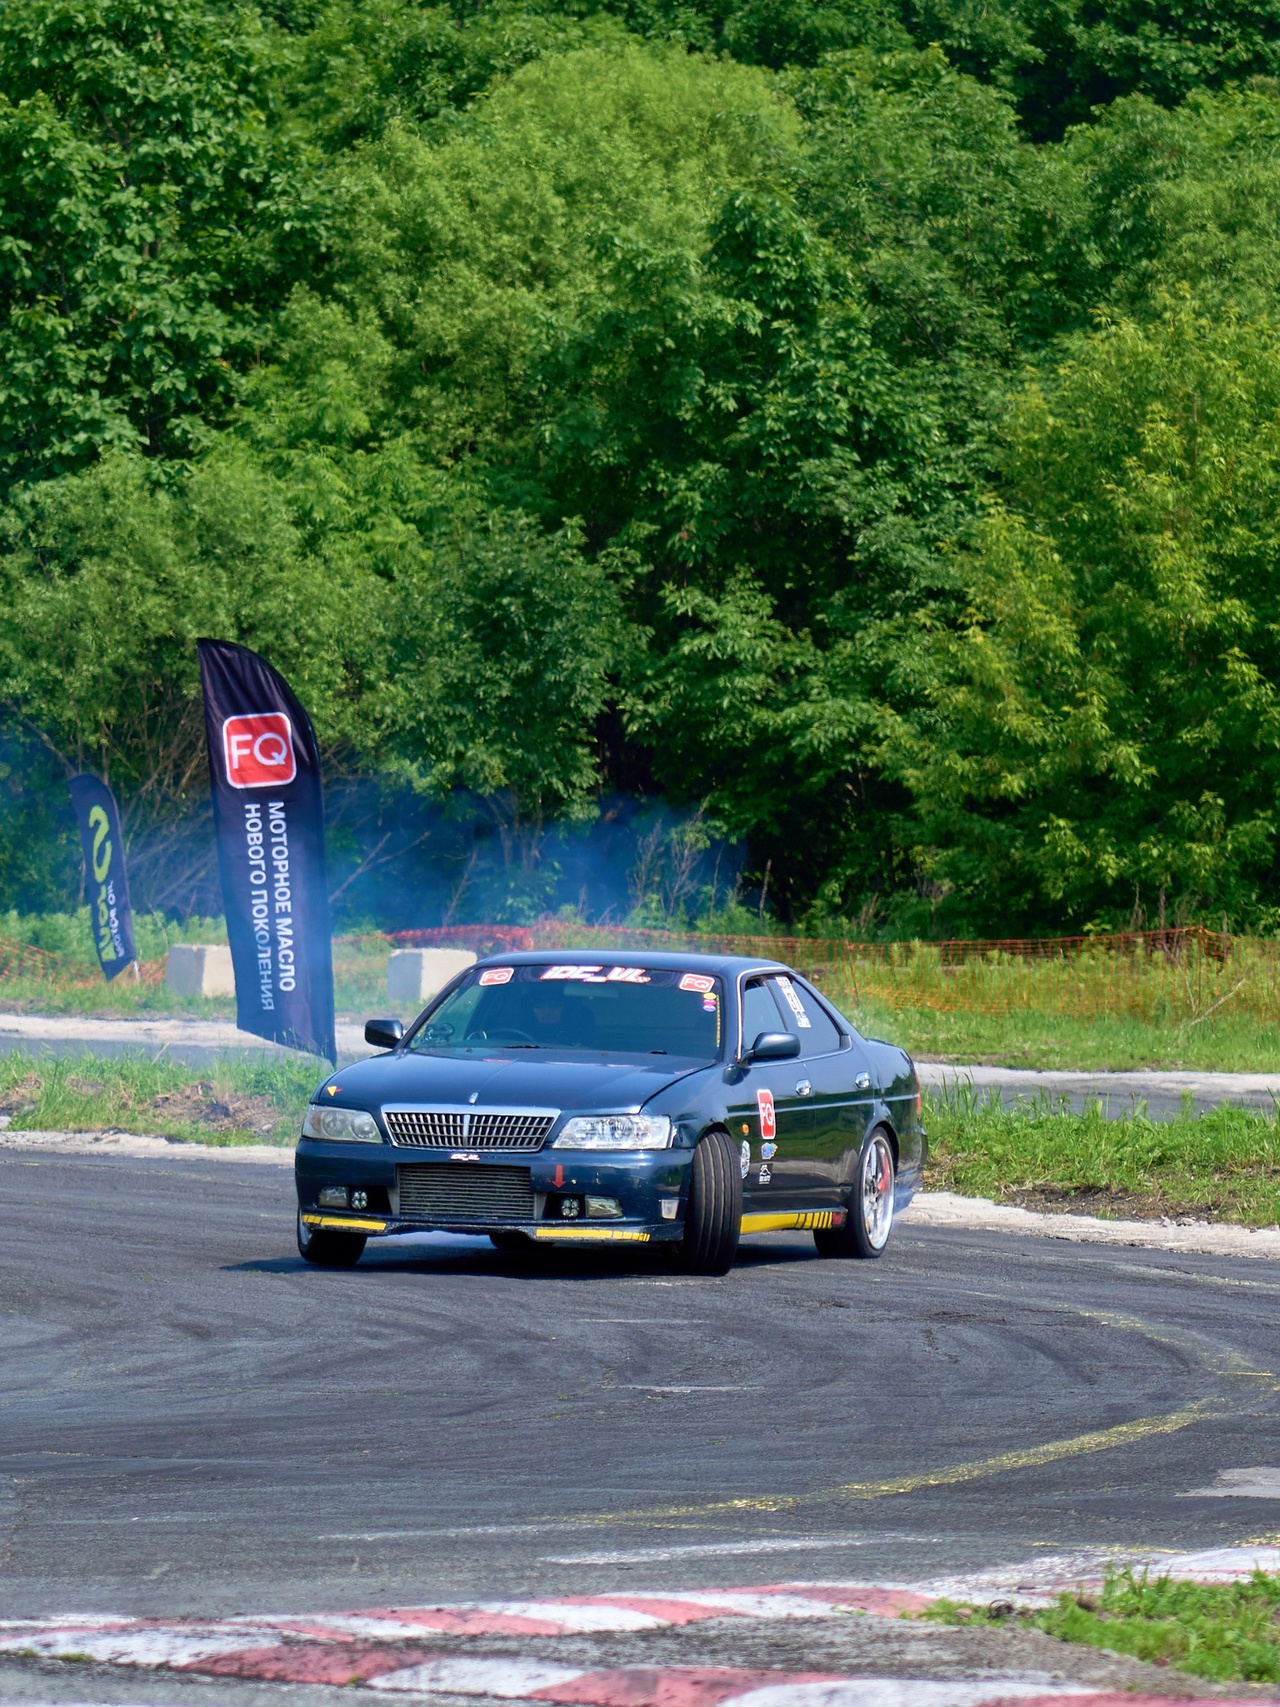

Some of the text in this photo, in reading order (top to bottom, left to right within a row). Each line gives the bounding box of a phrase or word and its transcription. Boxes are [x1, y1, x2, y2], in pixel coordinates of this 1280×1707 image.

[229, 733, 289, 769] FQ
[244, 803, 275, 1011] НОВОГО ПОКОЛЕНИЯ
[268, 801, 296, 993] МОТОРНОЕ МАСЛО
[483, 971, 509, 982] FQ
[683, 978, 710, 989] FQ
[760, 1103, 774, 1126] FQ
